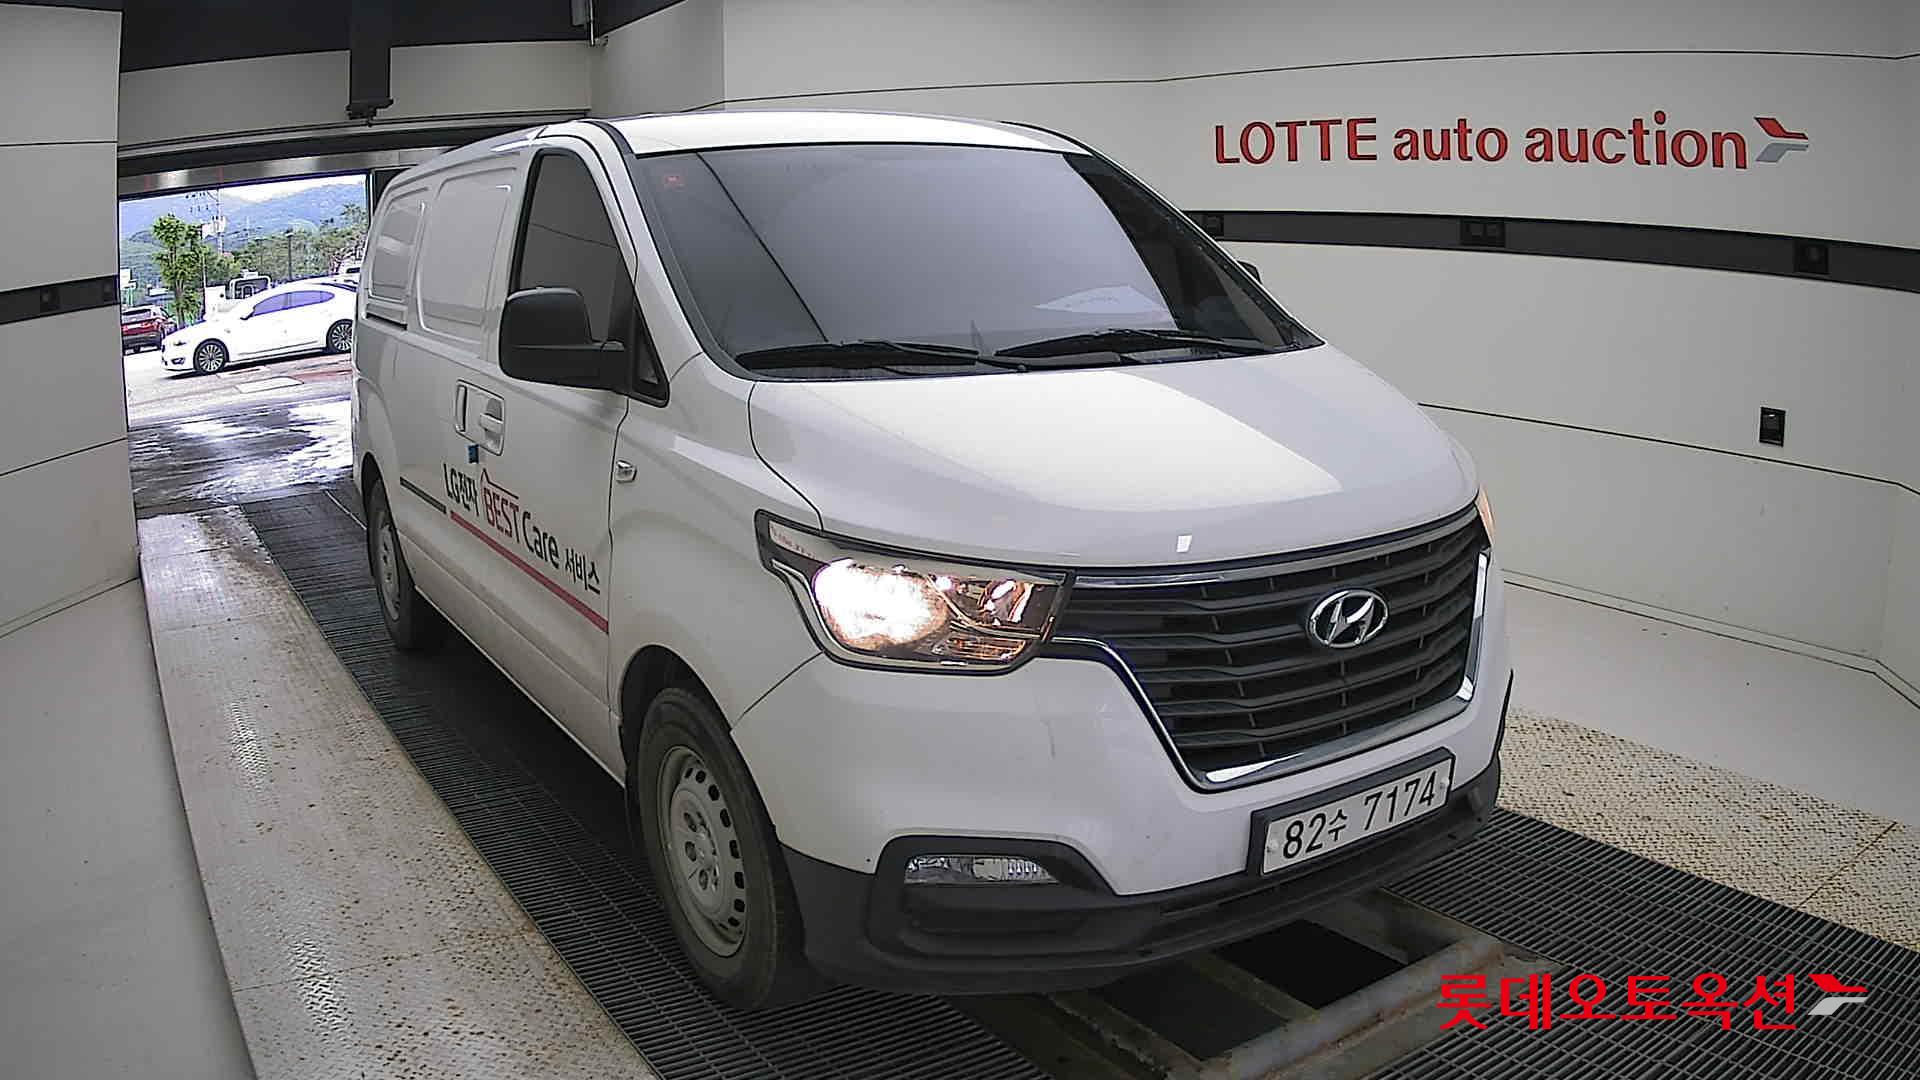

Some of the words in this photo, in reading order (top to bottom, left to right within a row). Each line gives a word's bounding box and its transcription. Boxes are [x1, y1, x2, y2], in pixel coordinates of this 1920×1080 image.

[1214, 117, 1378, 165] LOTTE
[1393, 118, 1508, 163] auto
[1524, 110, 1748, 170] auction
[443, 463, 479, 517] LG전자
[483, 487, 520, 543] BEST
[522, 510, 560, 569] Care
[565, 548, 601, 595] 서비스
[1283, 808, 1348, 860] 82수
[1363, 770, 1437, 831] 7174
